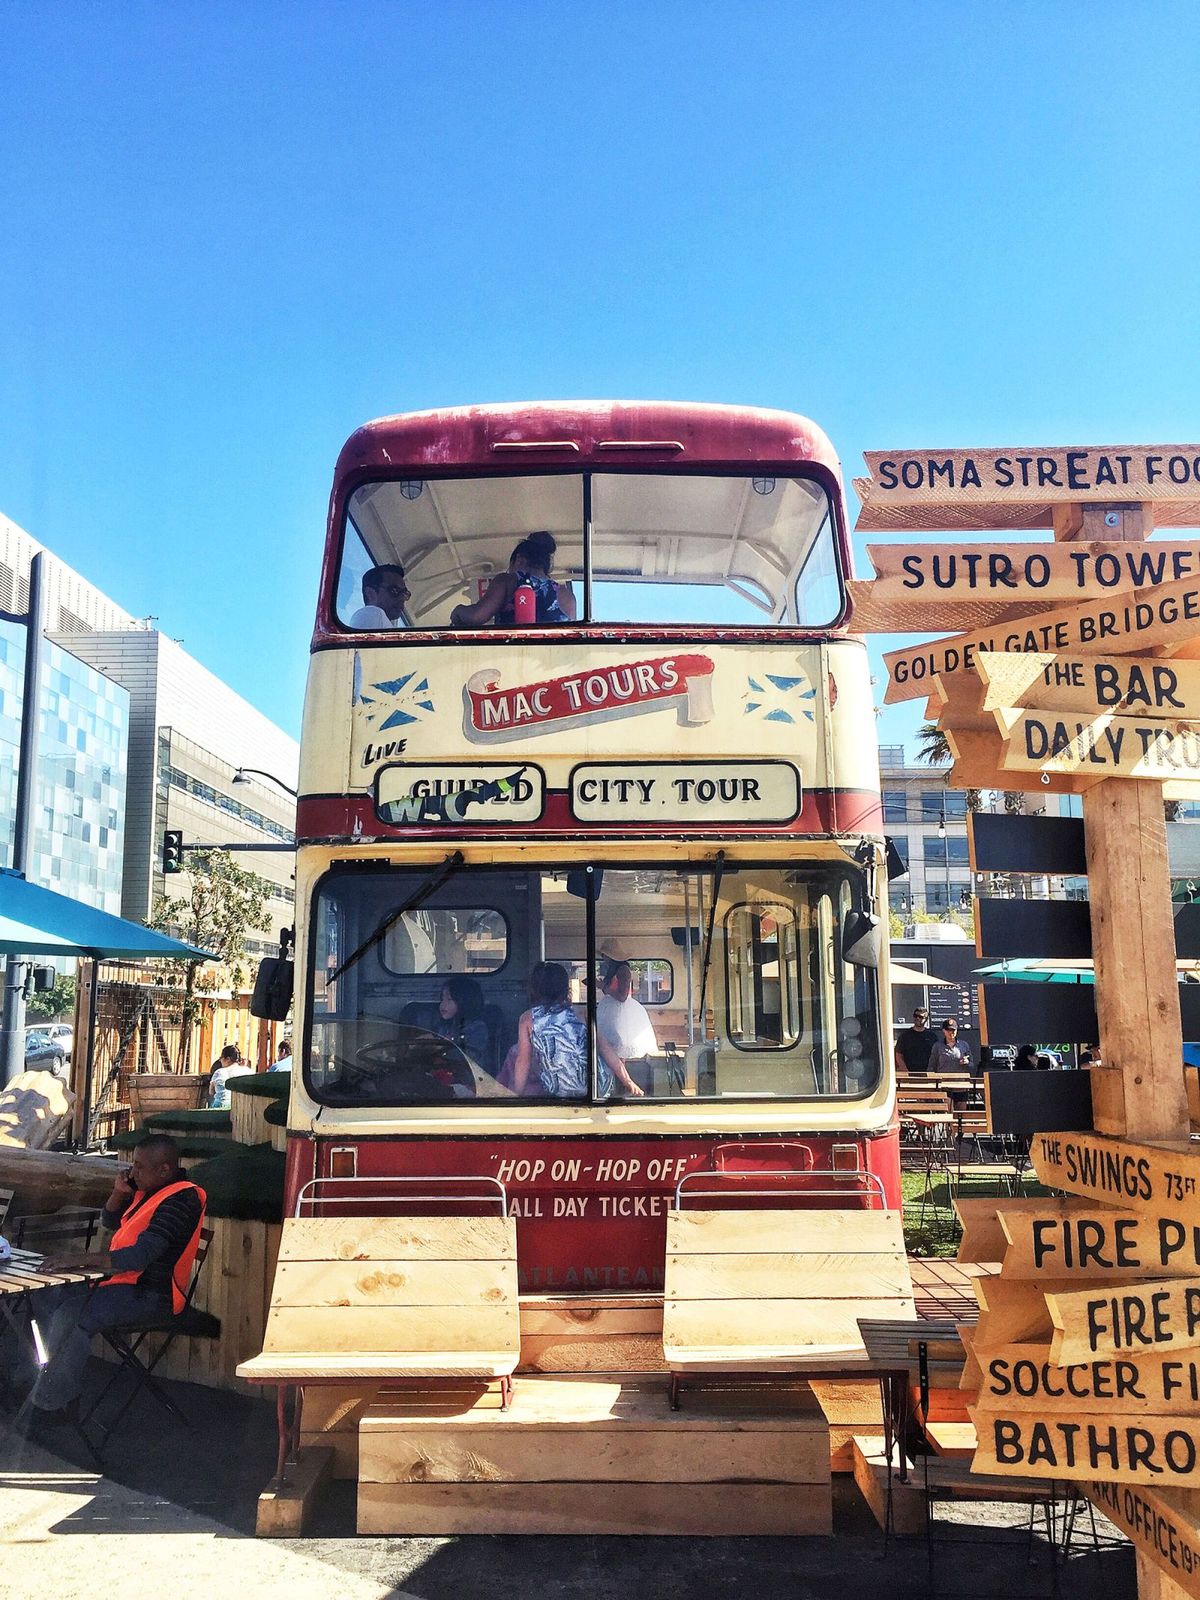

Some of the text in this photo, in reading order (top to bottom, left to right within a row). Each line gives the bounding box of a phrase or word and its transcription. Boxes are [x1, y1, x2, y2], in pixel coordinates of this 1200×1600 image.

[879, 460, 982, 489] SOMA
[995, 453, 1132, 489] STREAT
[902, 551, 1200, 589] SUTRO TOWE
[1004, 622, 1069, 653] GATE
[1080, 591, 1200, 642] BRIDGE
[481, 660, 680, 727] MAC TOURS
[1040, 662, 1185, 708] THE BAR
[361, 738, 408, 768] LIVE
[1025, 719, 1125, 767] DAILY
[577, 778, 761, 805] CITY TOUR
[1041, 1139, 1063, 1166] THE
[1066, 1143, 1153, 1201] SWINGS
[508, 1196, 675, 1217] ALL DAY TICKET
[1033, 1219, 1141, 1268] FIRE
[1088, 1292, 1173, 1351] FIRE
[989, 1359, 1146, 1399] SOCCER
[994, 1420, 1196, 1474] BATHRO
[1124, 1488, 1179, 1569] OFFICE
